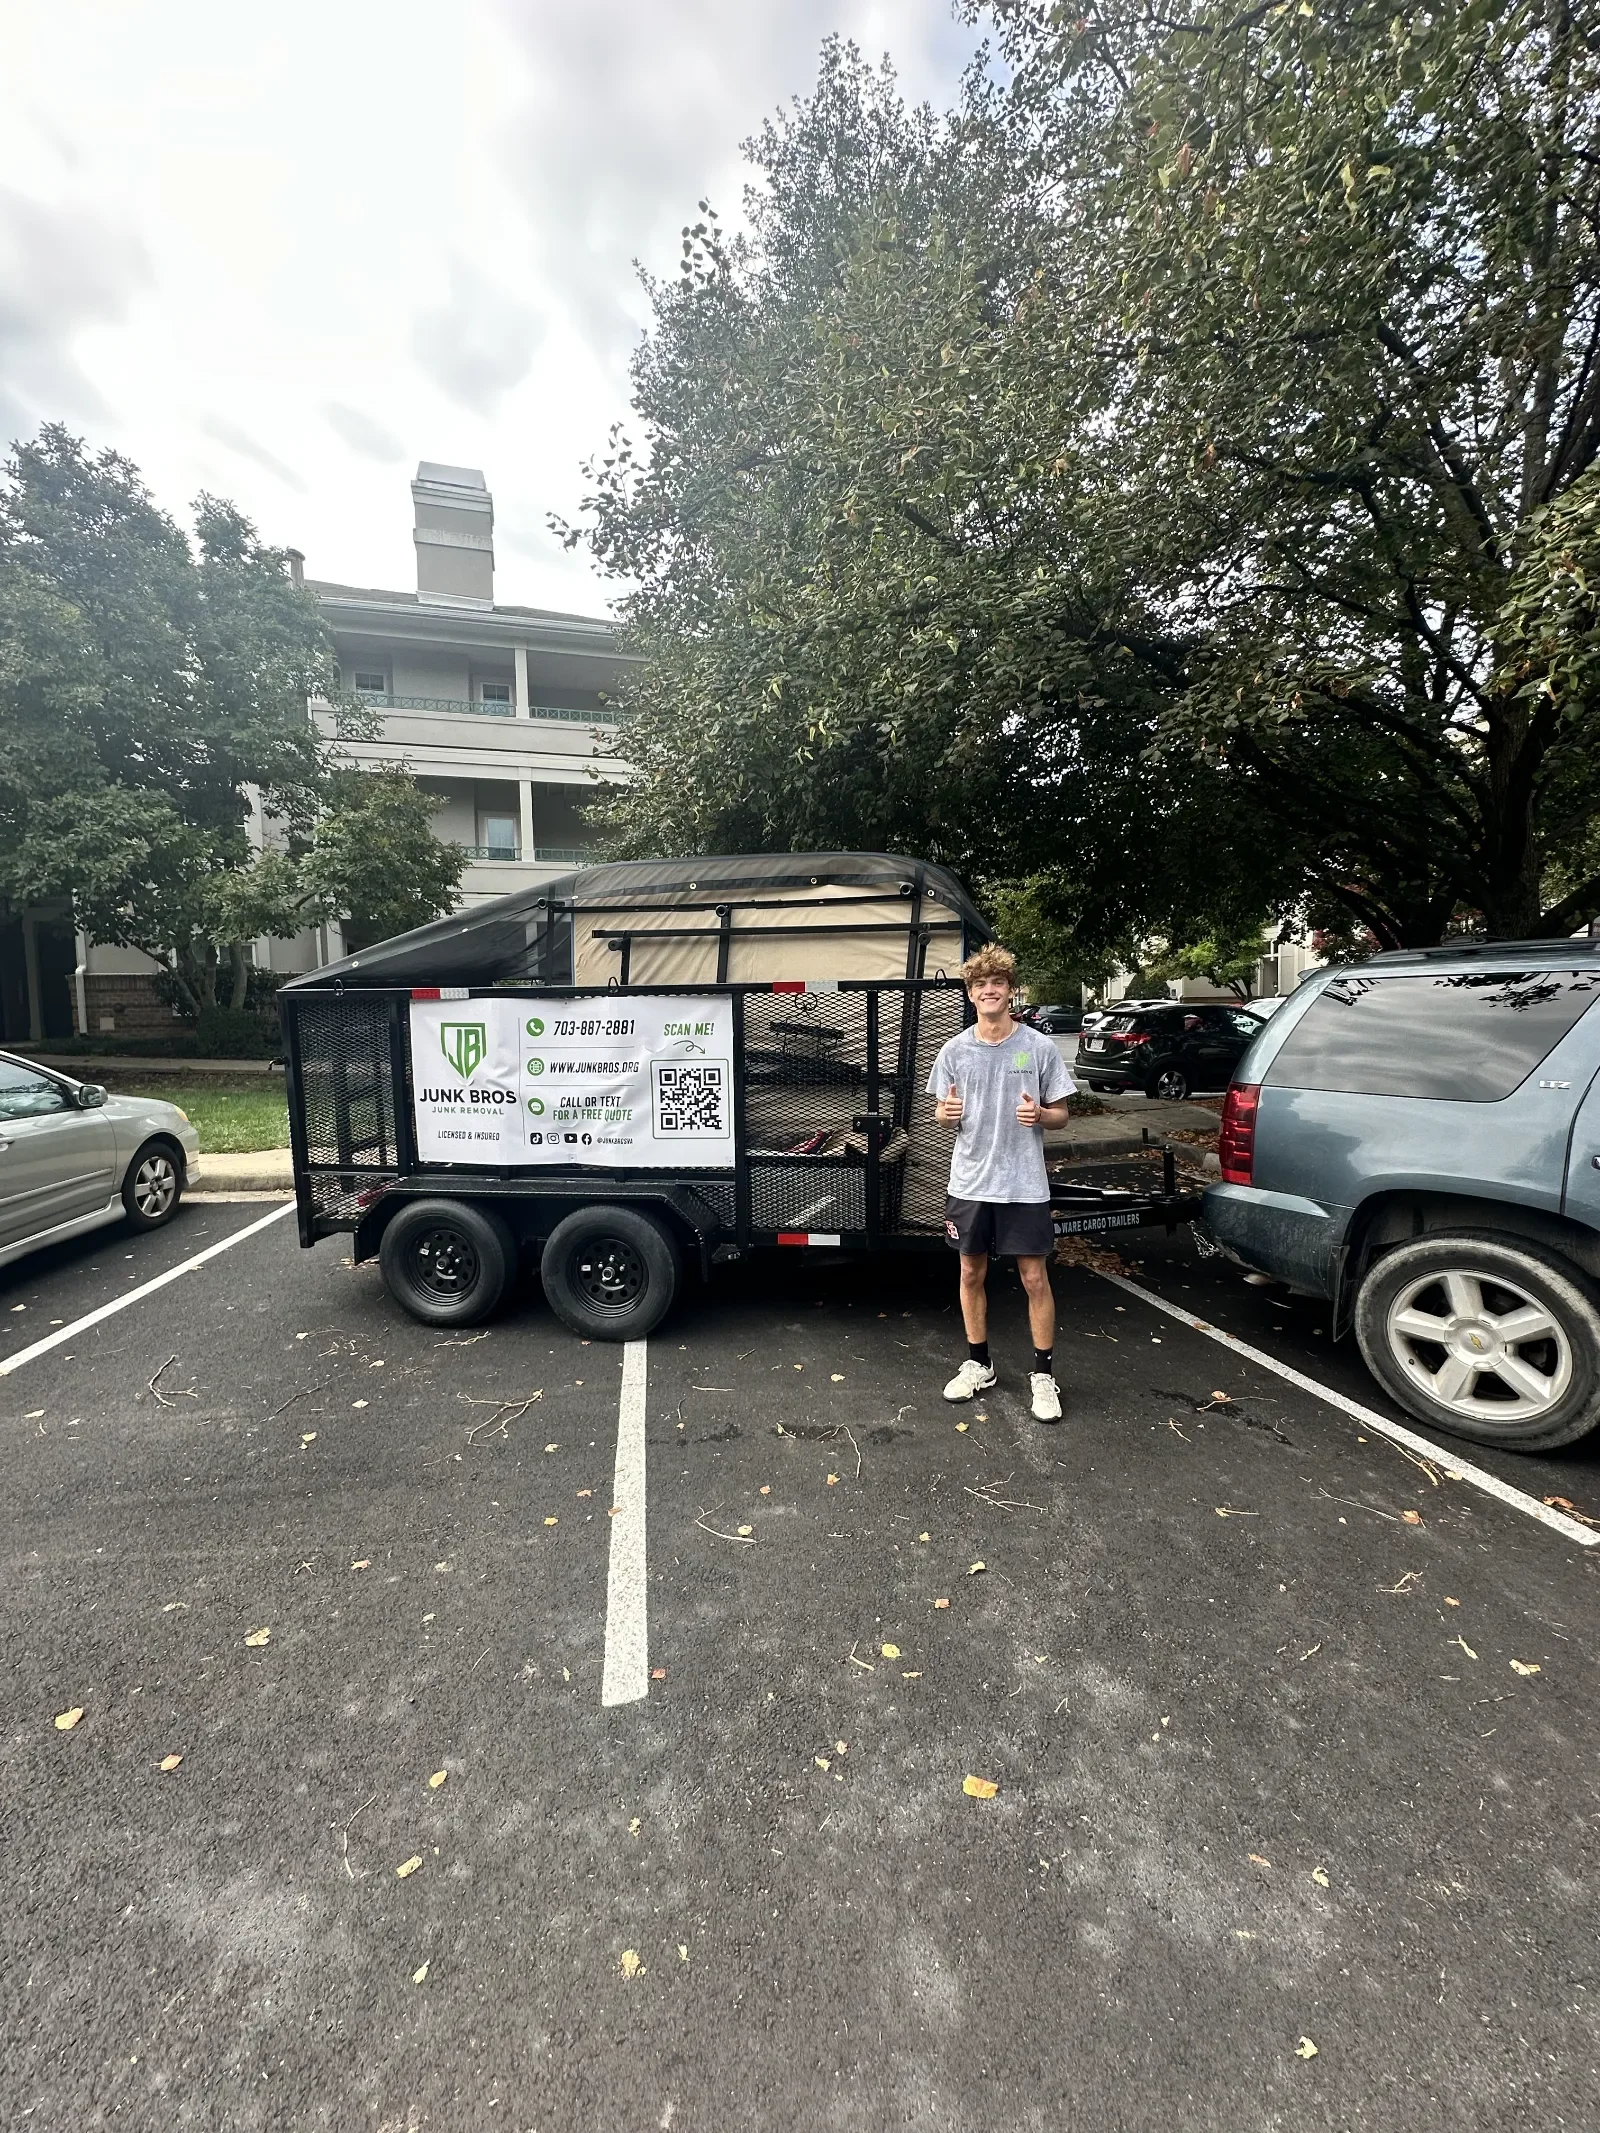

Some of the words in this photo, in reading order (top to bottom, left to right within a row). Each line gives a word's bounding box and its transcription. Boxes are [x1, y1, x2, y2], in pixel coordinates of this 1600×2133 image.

[553, 1019, 636, 1036] 703-887-2881
[663, 1023, 692, 1037] SCAN
[695, 1022, 715, 1036] ME!
[549, 1061, 640, 1074] WWW.JUNKBROS.ORG
[1539, 1080, 1572, 1089] LTZ
[420, 1089, 465, 1103] JUNK
[470, 1090, 517, 1104] BROS
[560, 1096, 582, 1108] CALL
[585, 1096, 597, 1108] OR
[600, 1096, 621, 1108] TEXT
[432, 1106, 457, 1114] JUNK
[460, 1107, 504, 1116] REMOVAL
[553, 1108, 570, 1121] FOR
[572, 1109, 579, 1120] A
[581, 1109, 602, 1120] FREE
[605, 1109, 633, 1122] QUOTE
[438, 1131, 466, 1140] LICENSED
[474, 1132, 500, 1141] INSURED
[1083, 1217, 1106, 1230] CARGO
[1107, 1213, 1139, 1228] TRAILERS
